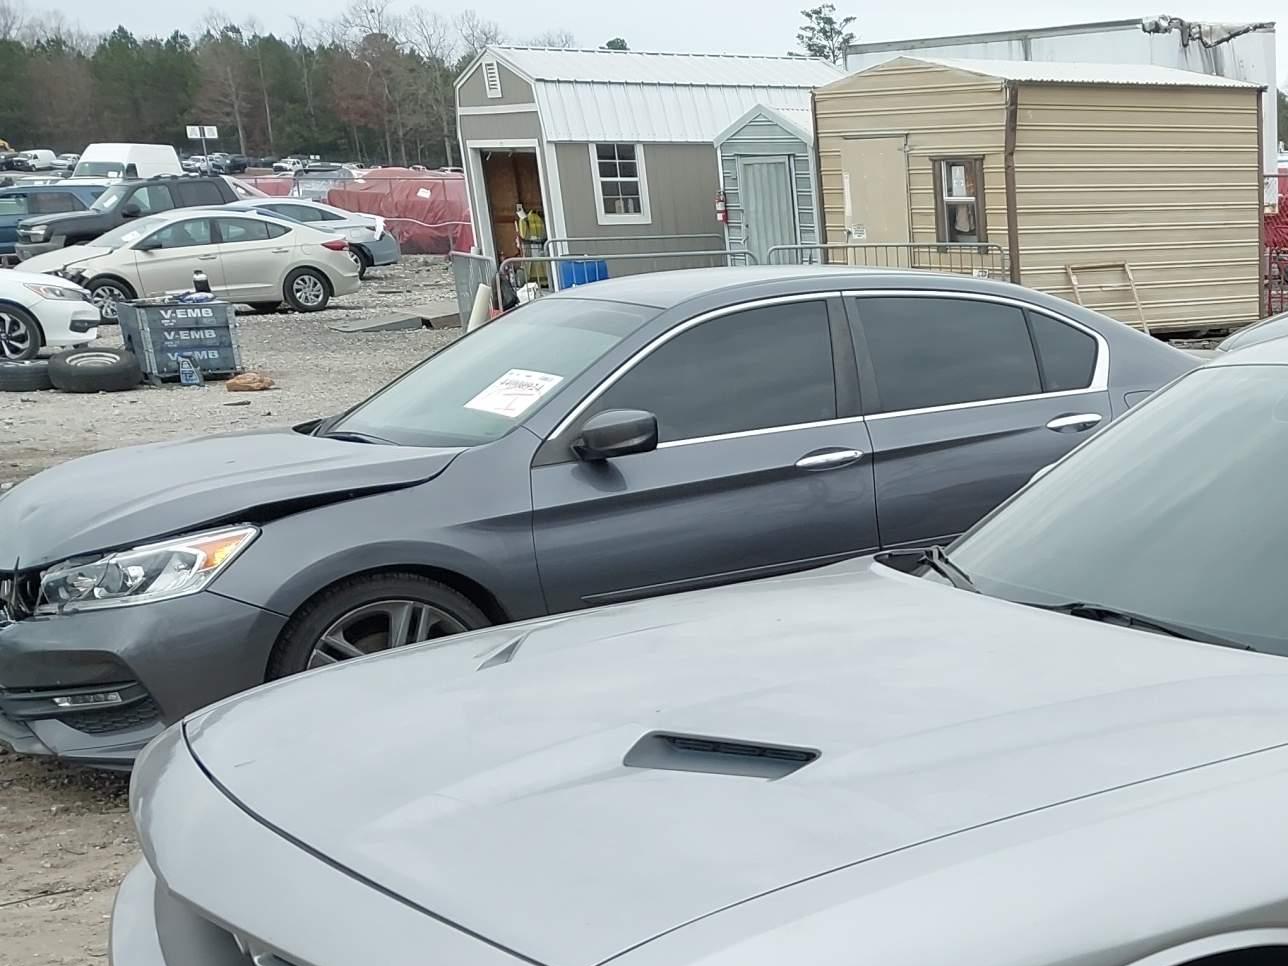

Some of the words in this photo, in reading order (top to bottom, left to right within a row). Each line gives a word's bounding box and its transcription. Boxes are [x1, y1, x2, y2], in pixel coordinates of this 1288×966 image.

[160, 308, 213, 318] V-EMB
[164, 329, 216, 339] V-EMB
[167, 350, 218, 360] VMB
